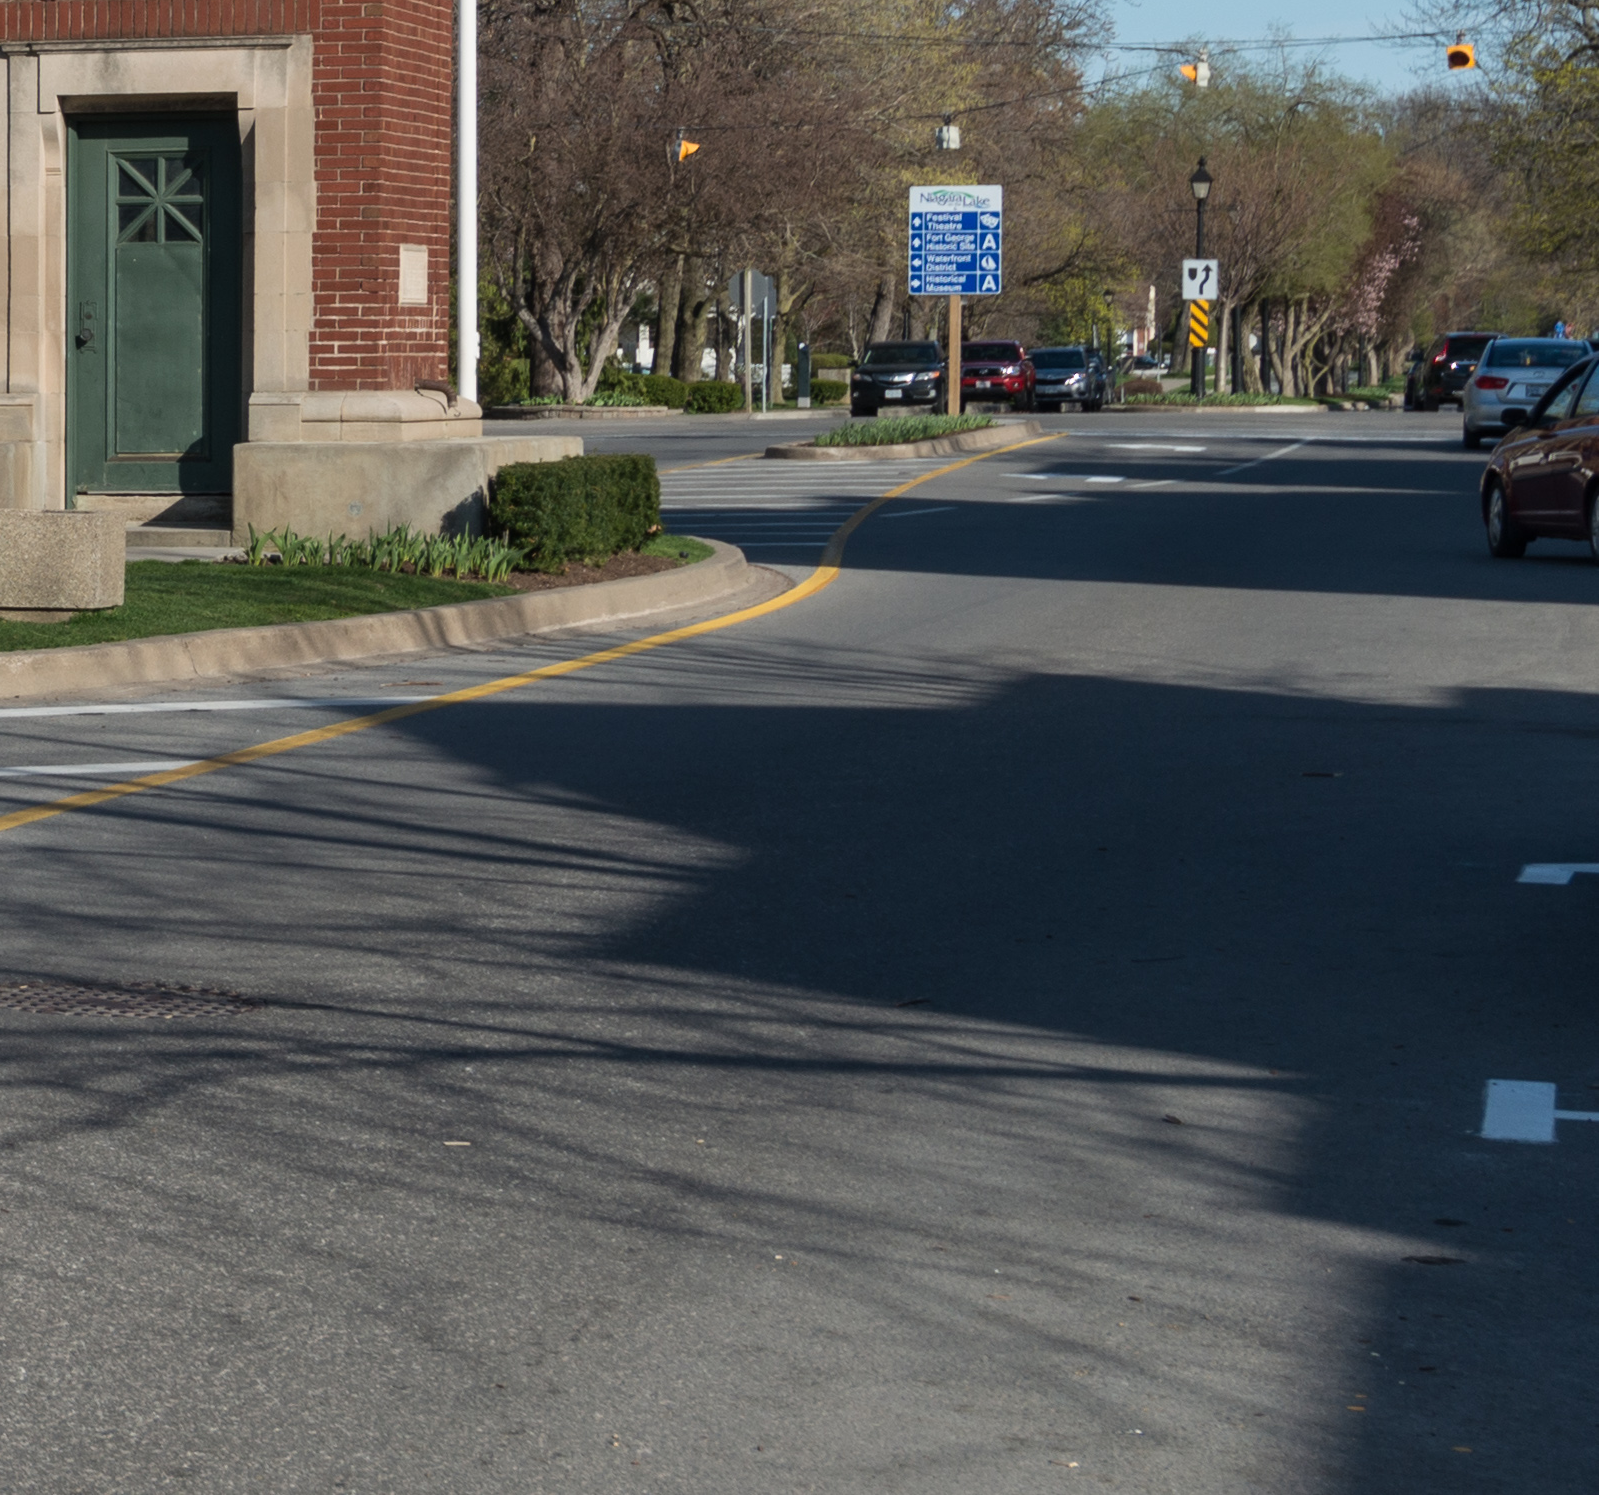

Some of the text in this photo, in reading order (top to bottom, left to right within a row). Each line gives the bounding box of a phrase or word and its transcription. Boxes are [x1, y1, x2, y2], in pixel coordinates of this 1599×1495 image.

[920, 192, 990, 207] Niagara Lake
[926, 213, 962, 221] Festival
[927, 222, 962, 230] Theatre
[926, 233, 975, 243] Fort George
[926, 242, 976, 250] Historic Site
[926, 254, 971, 262] Waterfront
[926, 263, 957, 271] District
[926, 275, 966, 283] Historical
[926, 284, 962, 292] Museum
